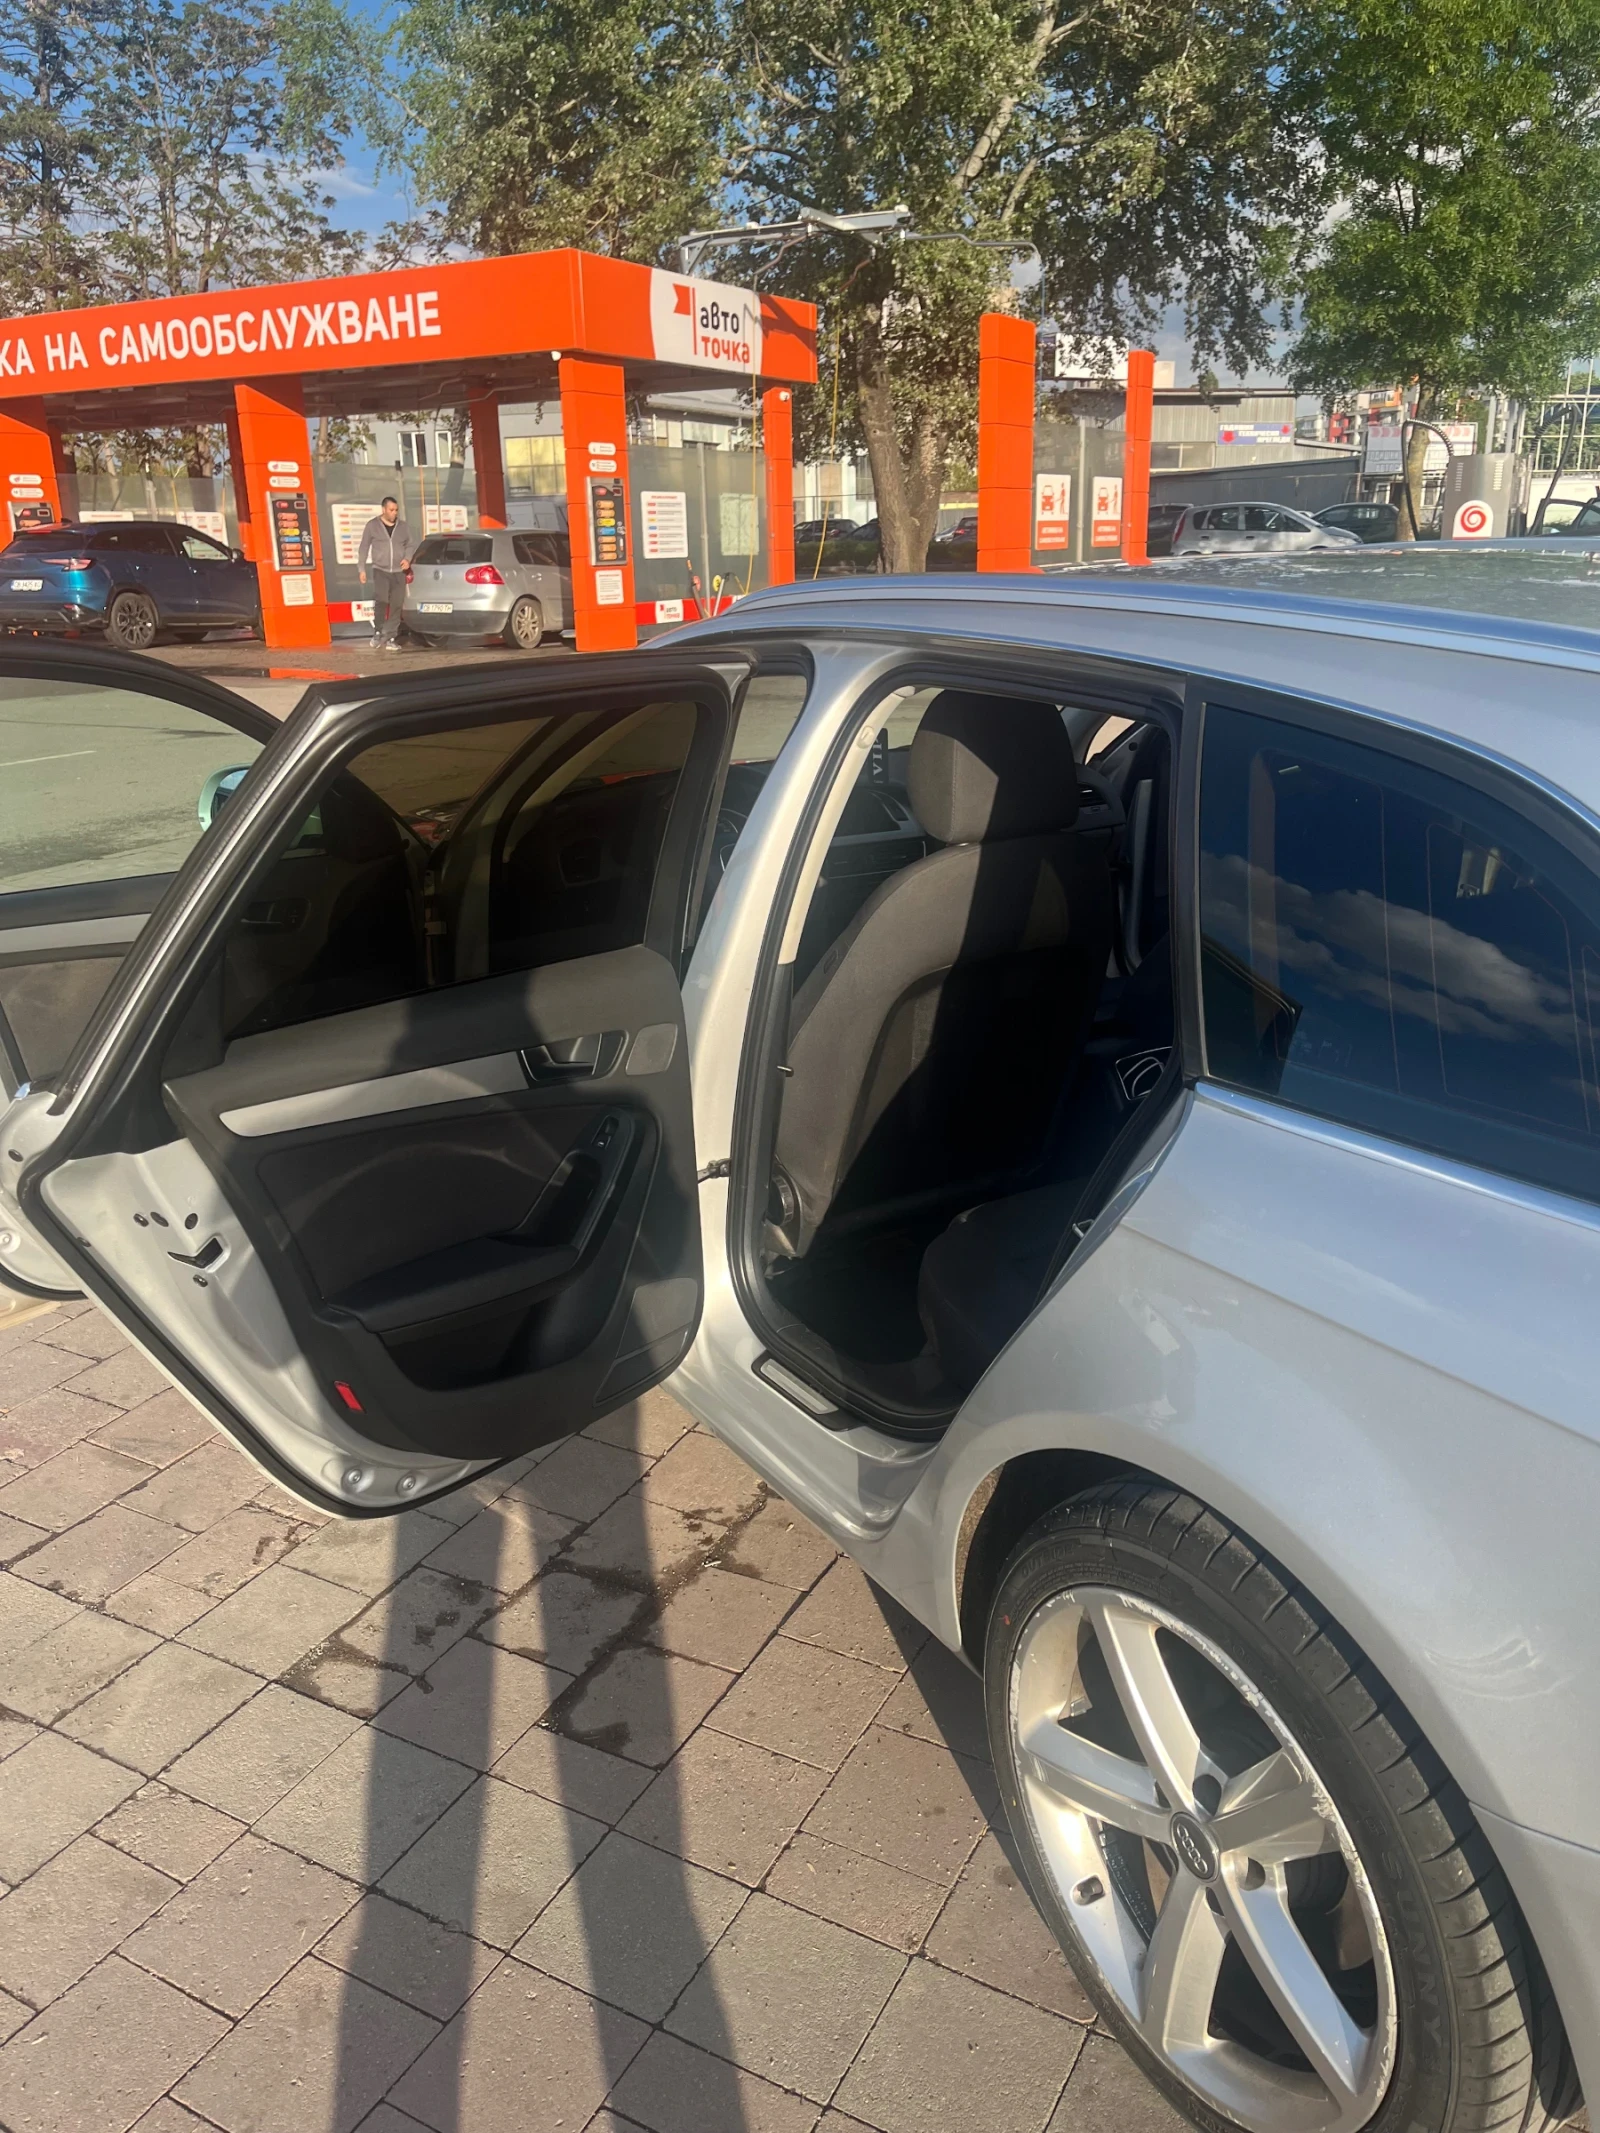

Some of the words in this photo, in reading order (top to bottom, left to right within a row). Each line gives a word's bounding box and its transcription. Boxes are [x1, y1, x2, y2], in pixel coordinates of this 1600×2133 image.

[44, 331, 89, 372] НА
[99, 291, 442, 366] САМООБСЛУЖВАНЕ
[700, 301, 740, 334] авто
[701, 335, 750, 364] точка
[1381, 1851, 1442, 2048] SUNNY
